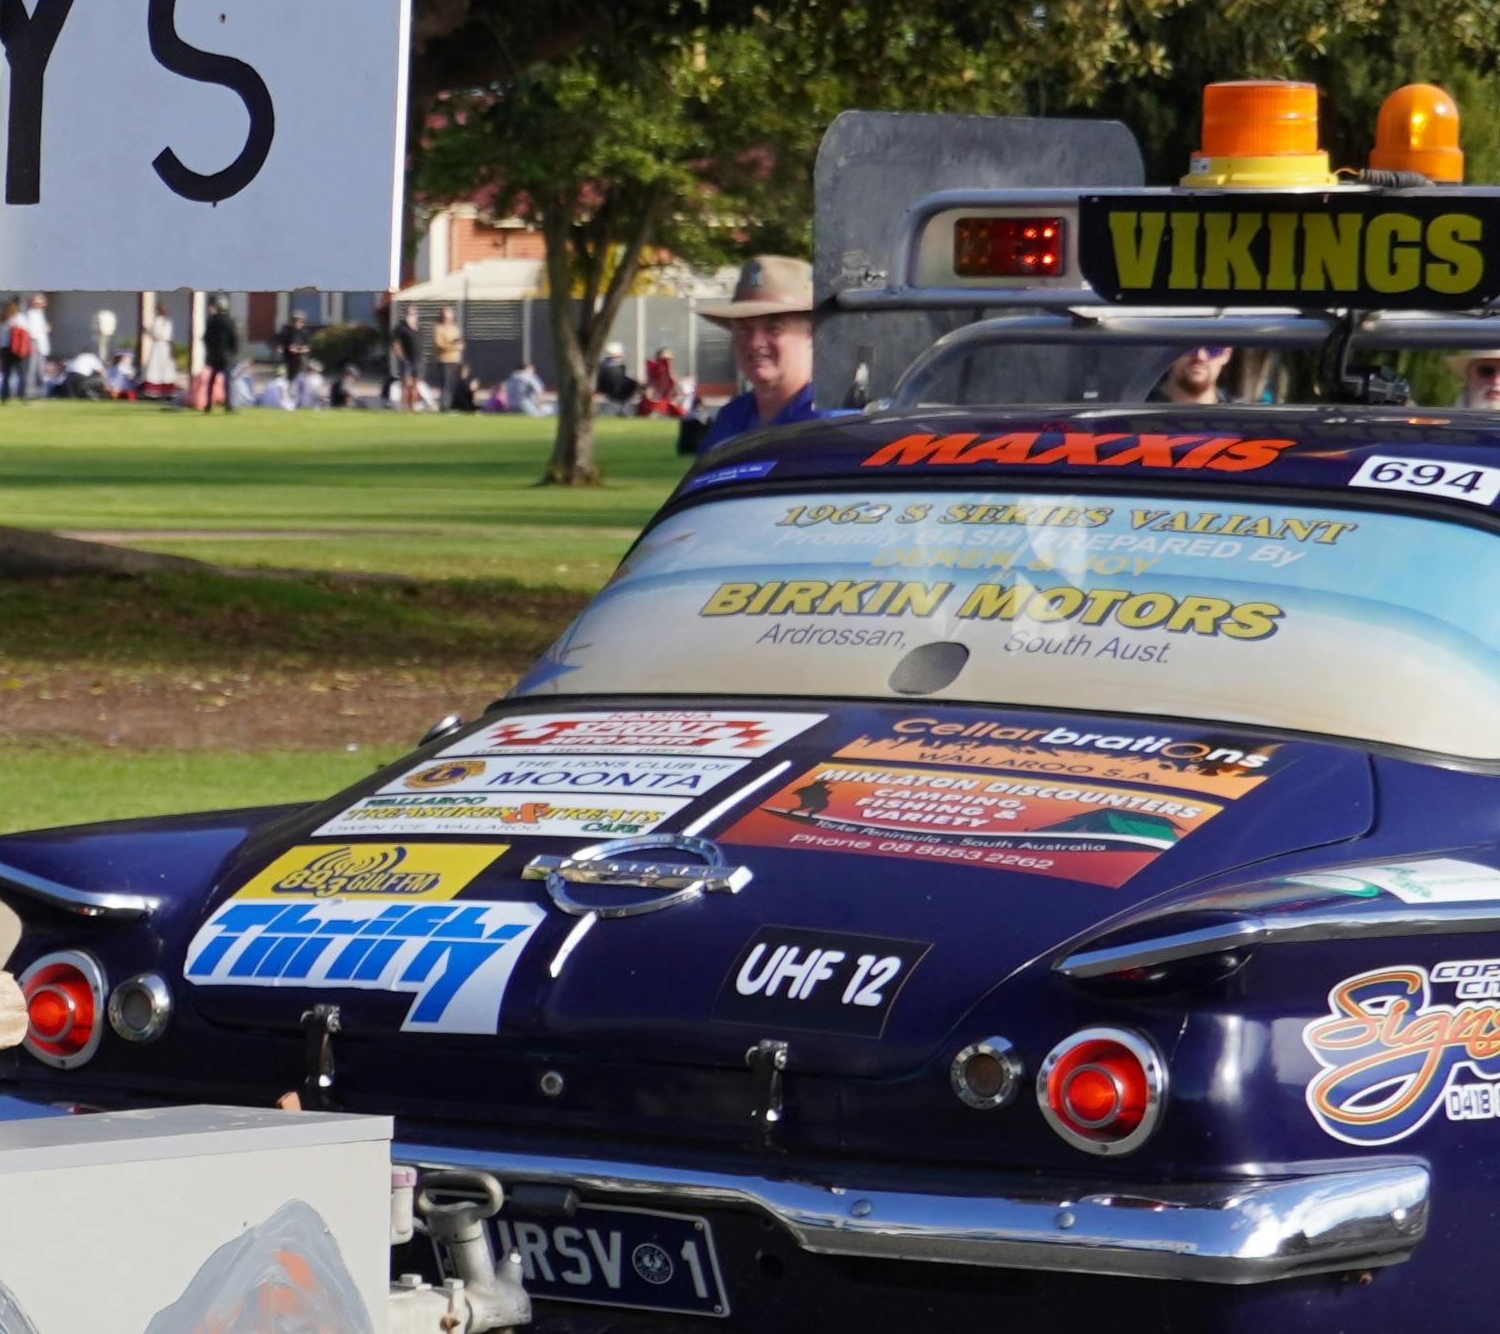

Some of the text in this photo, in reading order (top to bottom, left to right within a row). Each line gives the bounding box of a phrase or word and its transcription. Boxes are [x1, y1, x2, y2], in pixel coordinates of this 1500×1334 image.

[1108, 211, 1485, 295] VIKINGS
[860, 431, 1298, 472] MAXXIS
[1370, 462, 1485, 495] 694
[776, 503, 1357, 544] 1962 S SERIES VALIANT
[914, 528, 1023, 546] BASH
[1034, 531, 1242, 559] PREPARED
[1249, 543, 1306, 567] By
[700, 580, 1286, 641] BIRKIN MOTORS
[756, 623, 1172, 664] Ardrossan, South Aust.
[486, 771, 702, 789] MOONTA
[918, 752, 1096, 775] WALLAROO
[813, 768, 1205, 820] MINLATON DISCOUNTERS
[854, 797, 1019, 821] FISHING &
[873, 788, 1029, 812] CAMPING,
[815, 819, 858, 836] Yorke
[959, 837, 1014, 850] South
[1021, 840, 1108, 852] Australia
[860, 808, 990, 829] VARIETY
[789, 833, 872, 850] Phone
[877, 840, 912, 854] 08
[984, 852, 1055, 870] 2262
[188, 902, 532, 1024] Thrifty
[735, 943, 901, 1007] UHF 12
